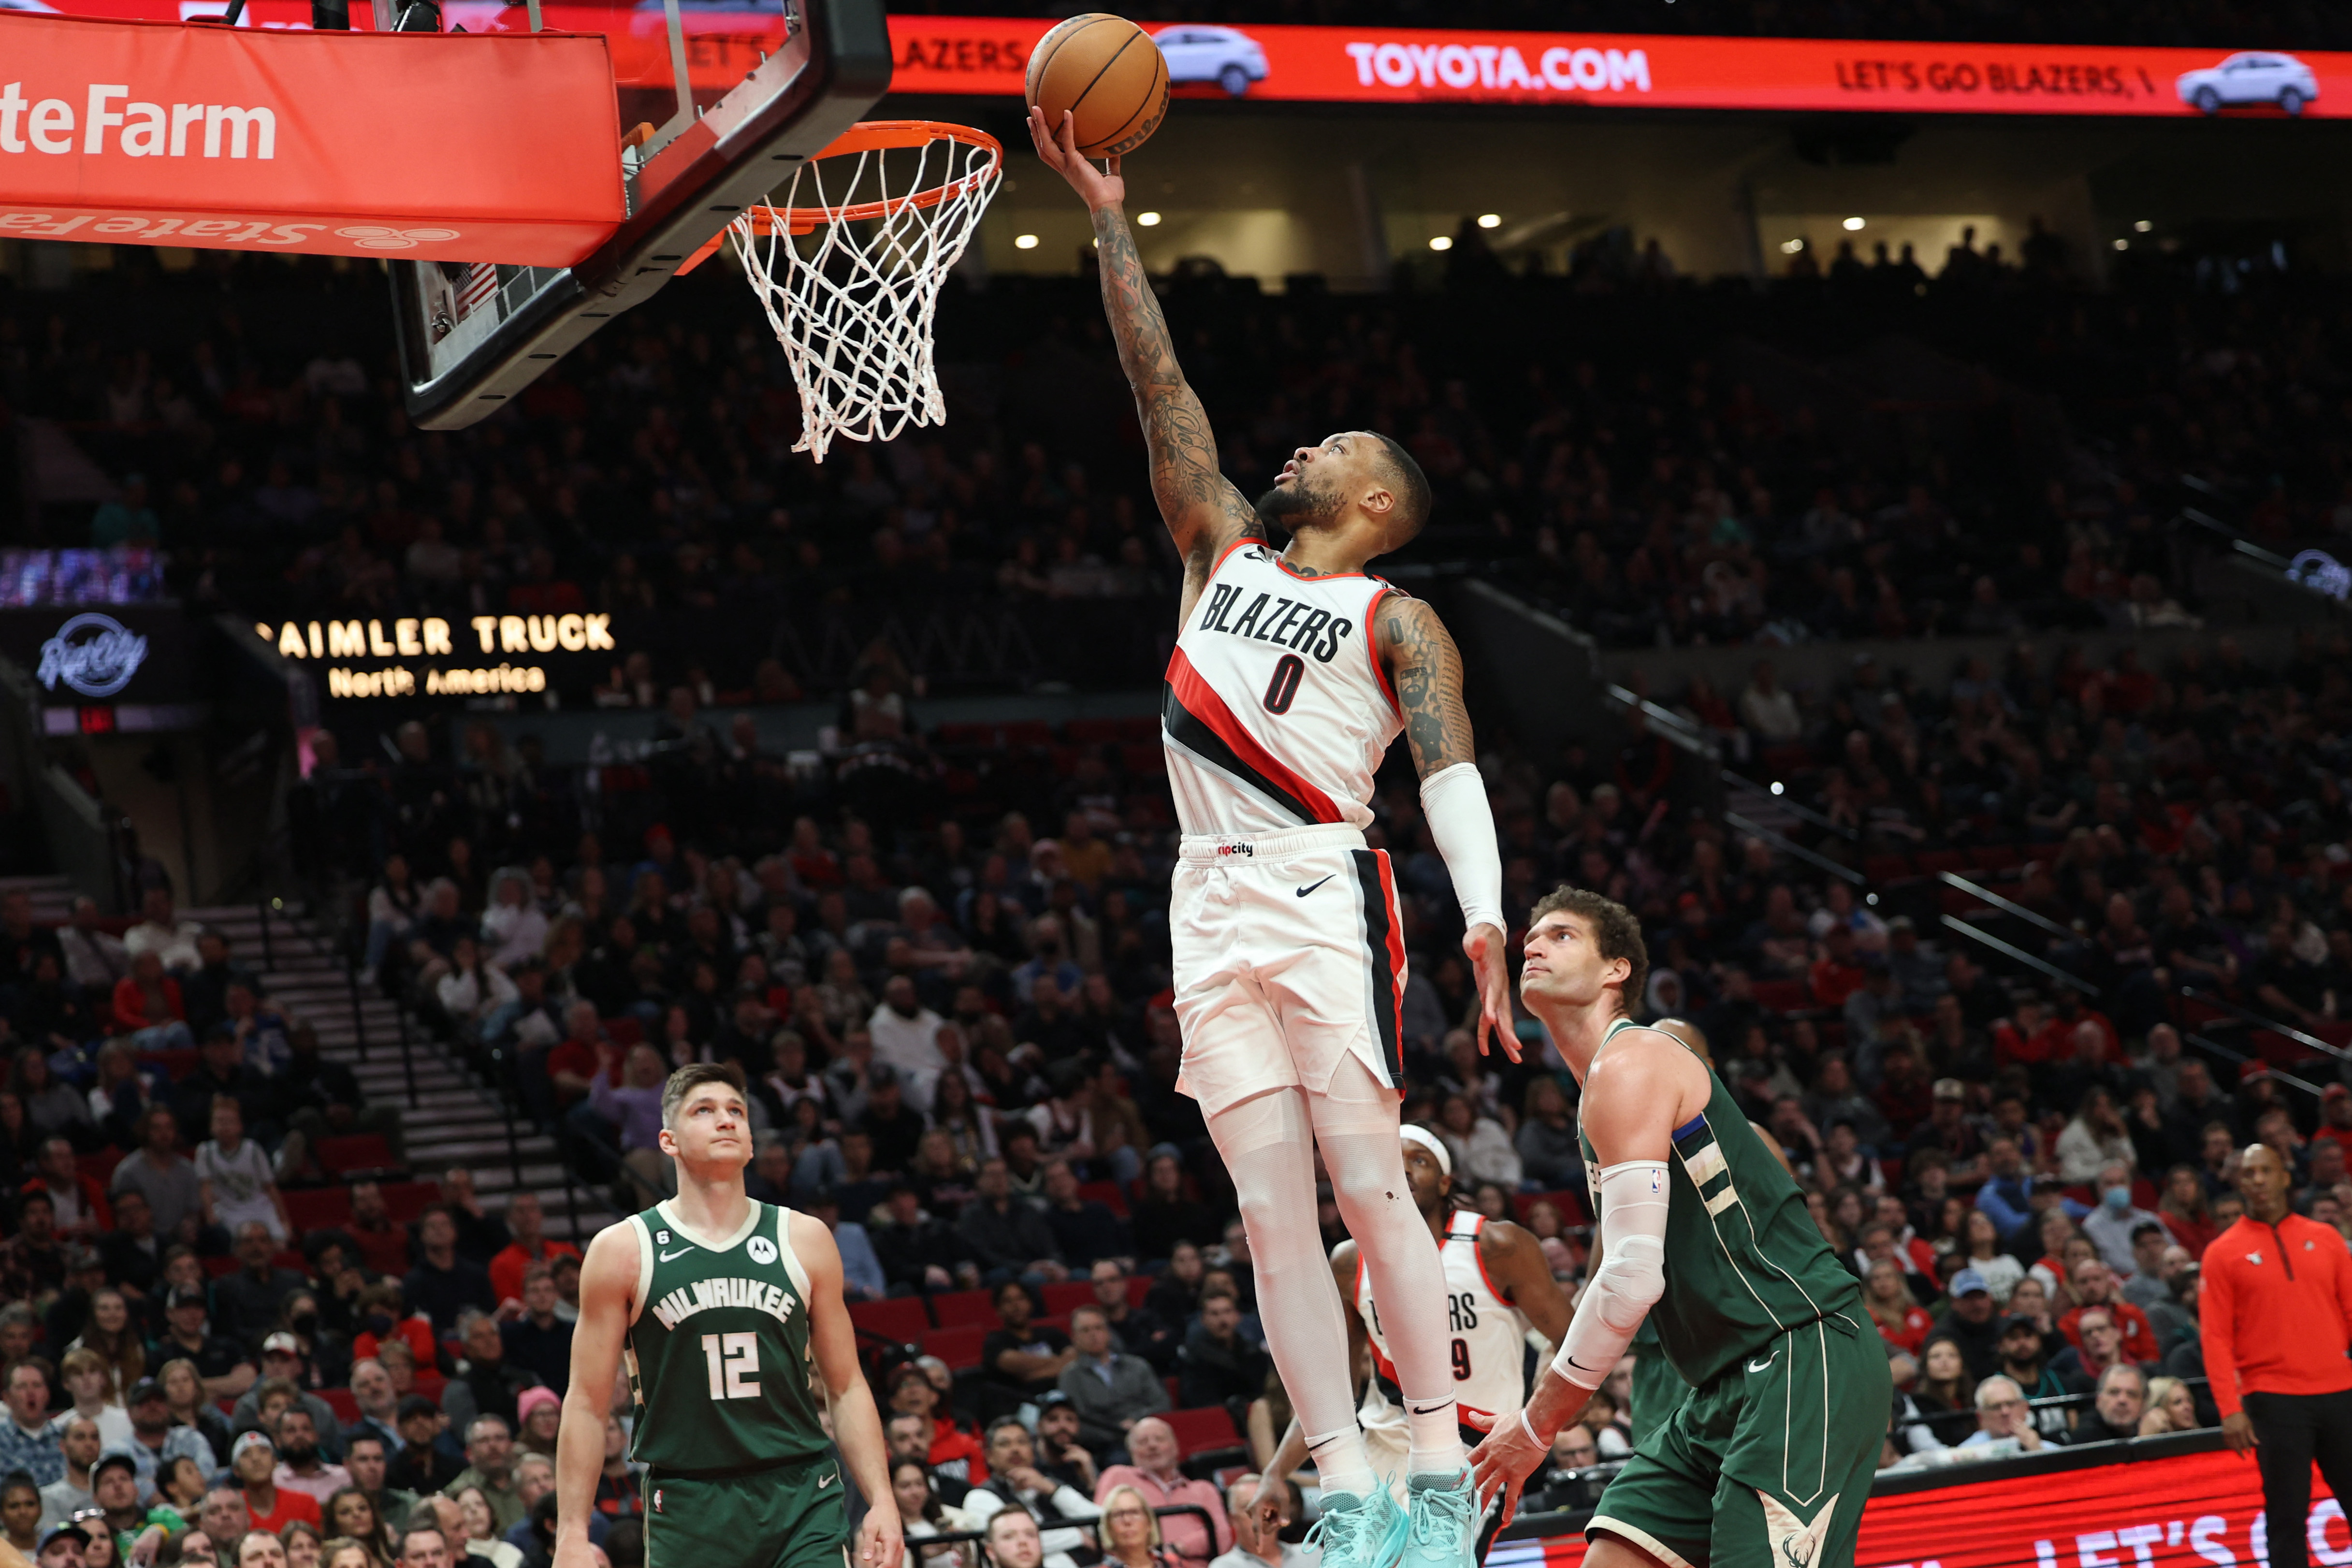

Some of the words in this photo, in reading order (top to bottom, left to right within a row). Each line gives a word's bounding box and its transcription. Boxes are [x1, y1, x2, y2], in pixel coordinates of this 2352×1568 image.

[1346, 43, 1651, 92] TOYOTA.COM
[1836, 60, 1920, 92] LET'S
[1927, 61, 1980, 93] GO
[255, 621, 452, 658] AIMLER
[471, 613, 615, 653] TRUCK
[1199, 583, 1352, 663] BLAZERS
[329, 667, 415, 698] North
[426, 662, 545, 695] America
[1263, 653, 1304, 715] 0
[1218, 842, 1253, 857] ripcity
[656, 1230, 670, 1245] 6
[652, 1278, 796, 1331] MILWAUKEE
[701, 1332, 761, 1400] 12
[1452, 1338, 1471, 1381] 9
